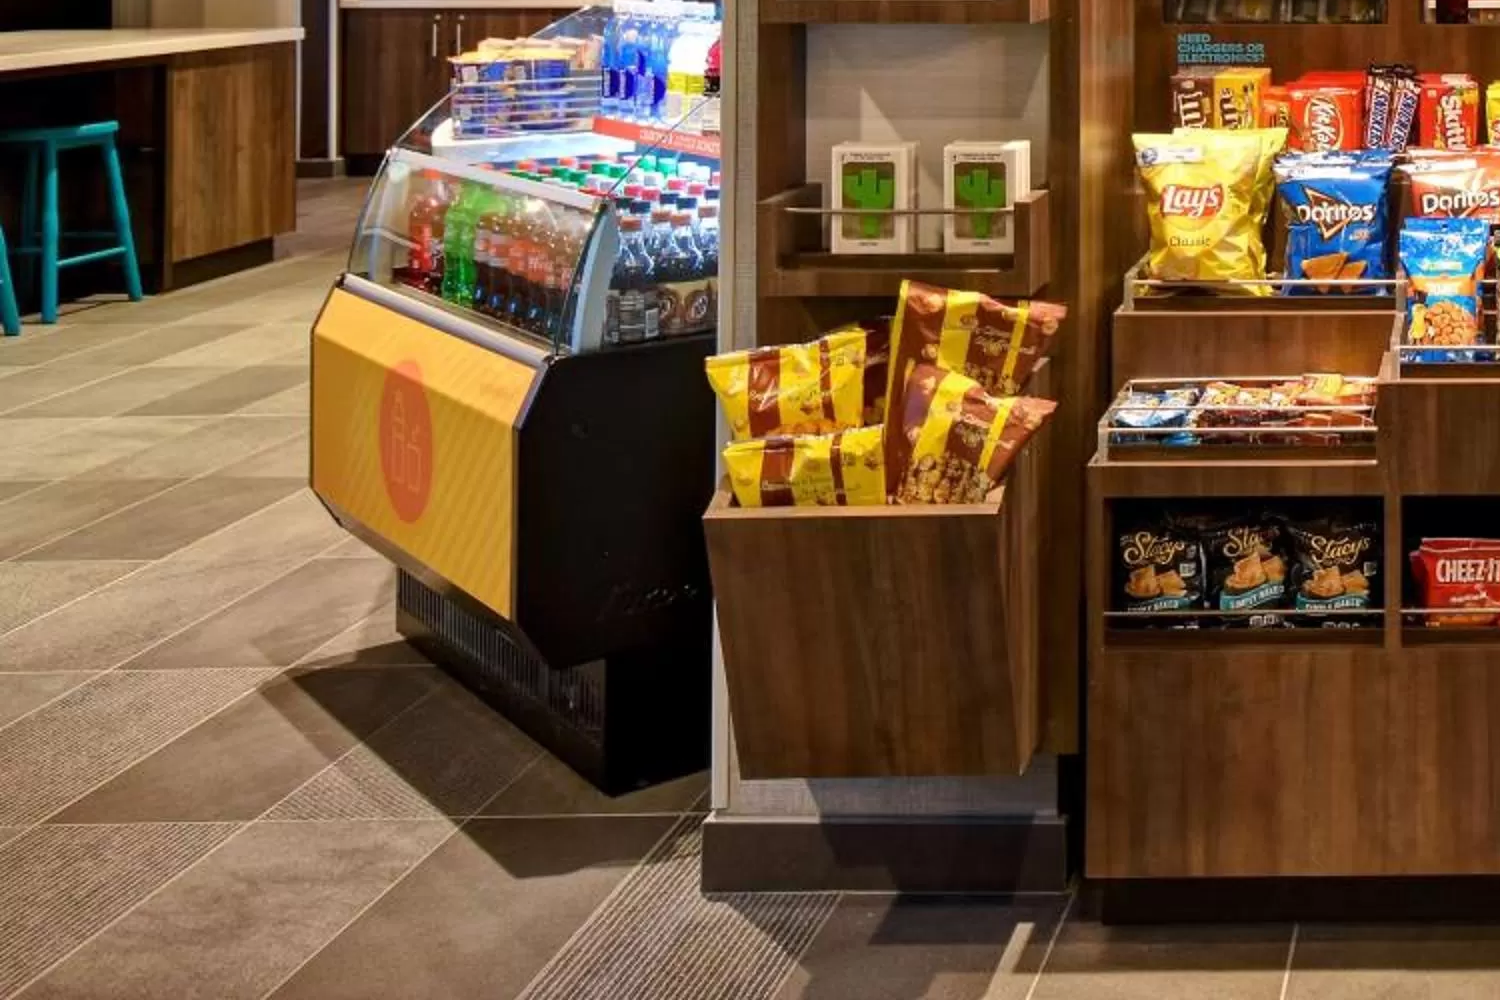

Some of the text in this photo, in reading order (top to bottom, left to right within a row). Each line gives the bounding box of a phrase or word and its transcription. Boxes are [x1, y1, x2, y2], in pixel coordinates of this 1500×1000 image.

[1441, 95, 1467, 150] Skittl
[1163, 185, 1222, 217] Lay's
[1297, 203, 1375, 224] Doritos
[1423, 190, 1500, 213] Doritos
[1309, 535, 1371, 564] Stacy's
